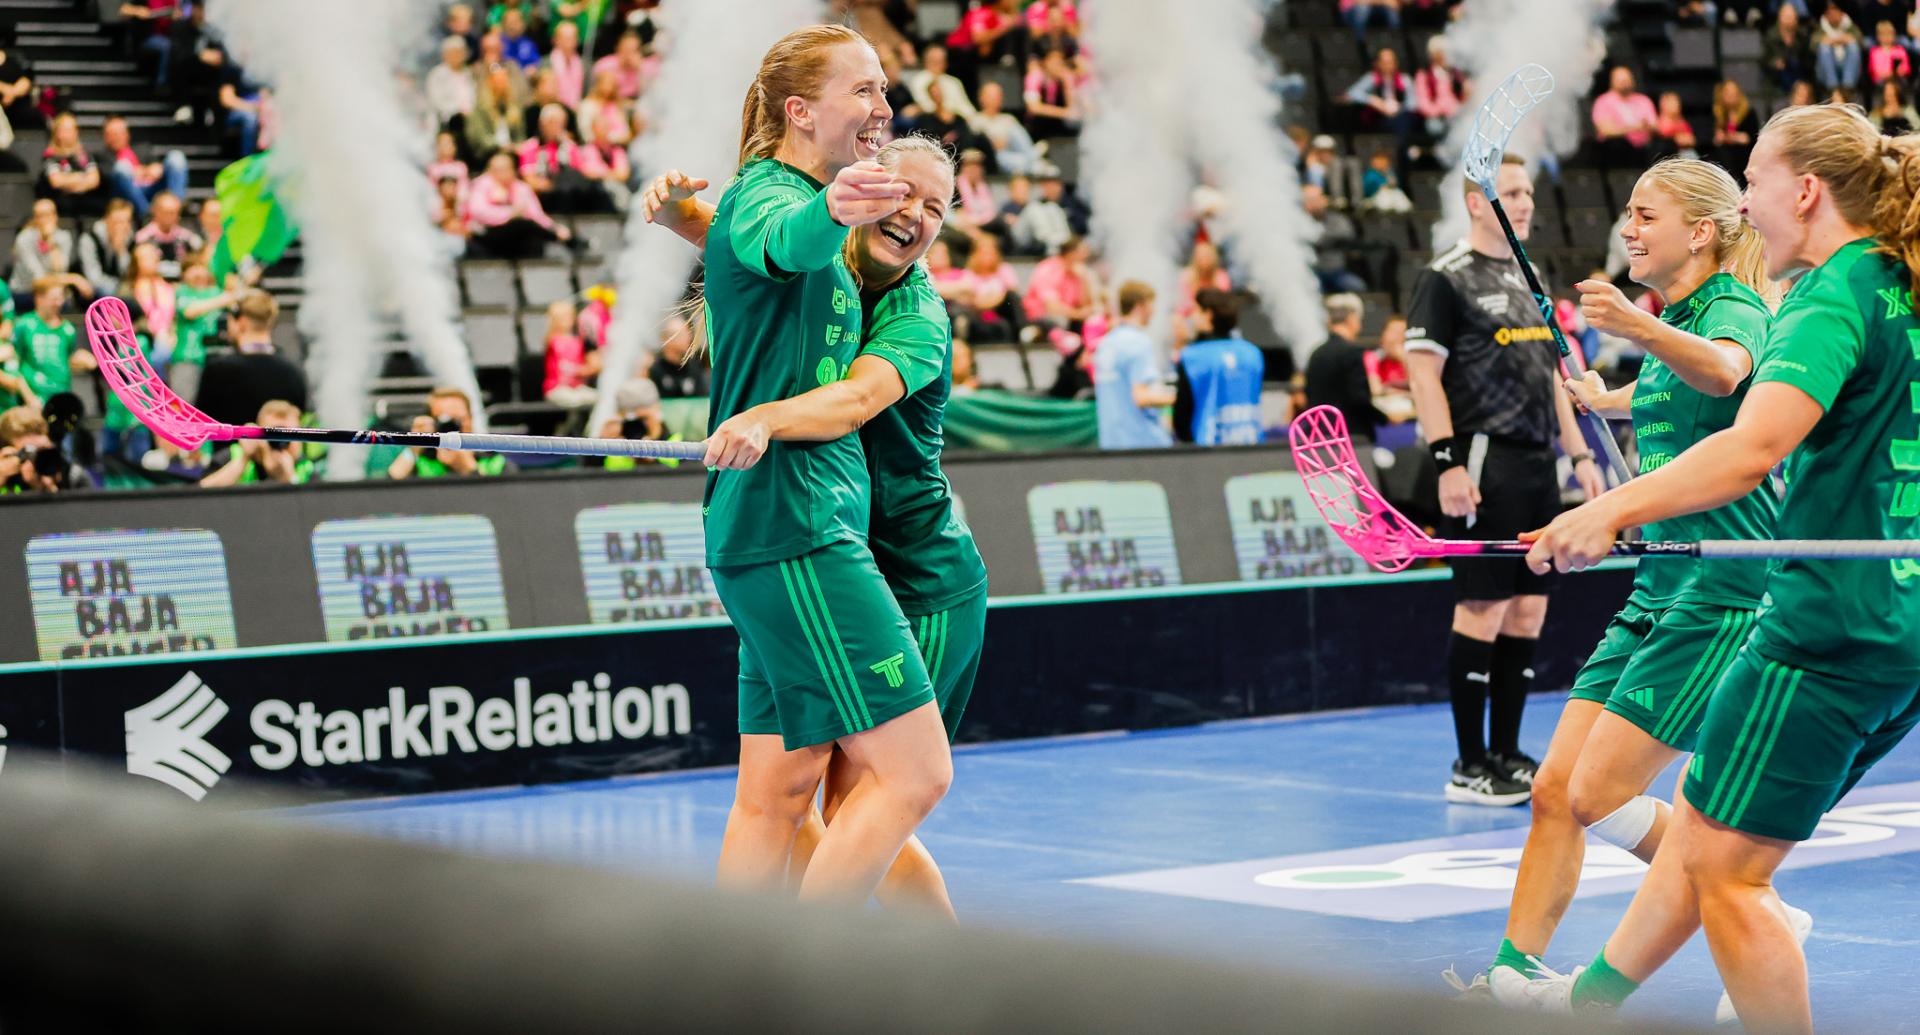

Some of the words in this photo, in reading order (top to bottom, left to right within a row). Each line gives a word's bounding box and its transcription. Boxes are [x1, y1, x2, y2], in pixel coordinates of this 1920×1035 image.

[1055, 508, 1103, 534] AJA
[1251, 497, 1296, 522] AJA
[606, 531, 665, 564] AJA
[1067, 538, 1137, 569] BAJA
[1264, 526, 1328, 555] BAJA
[344, 543, 410, 579] AJA
[60, 560, 132, 597] AJA
[621, 566, 706, 600] BAJA
[362, 575, 454, 619] BAJA
[76, 594, 178, 638] BAJA
[249, 671, 692, 771] StarkRelation
